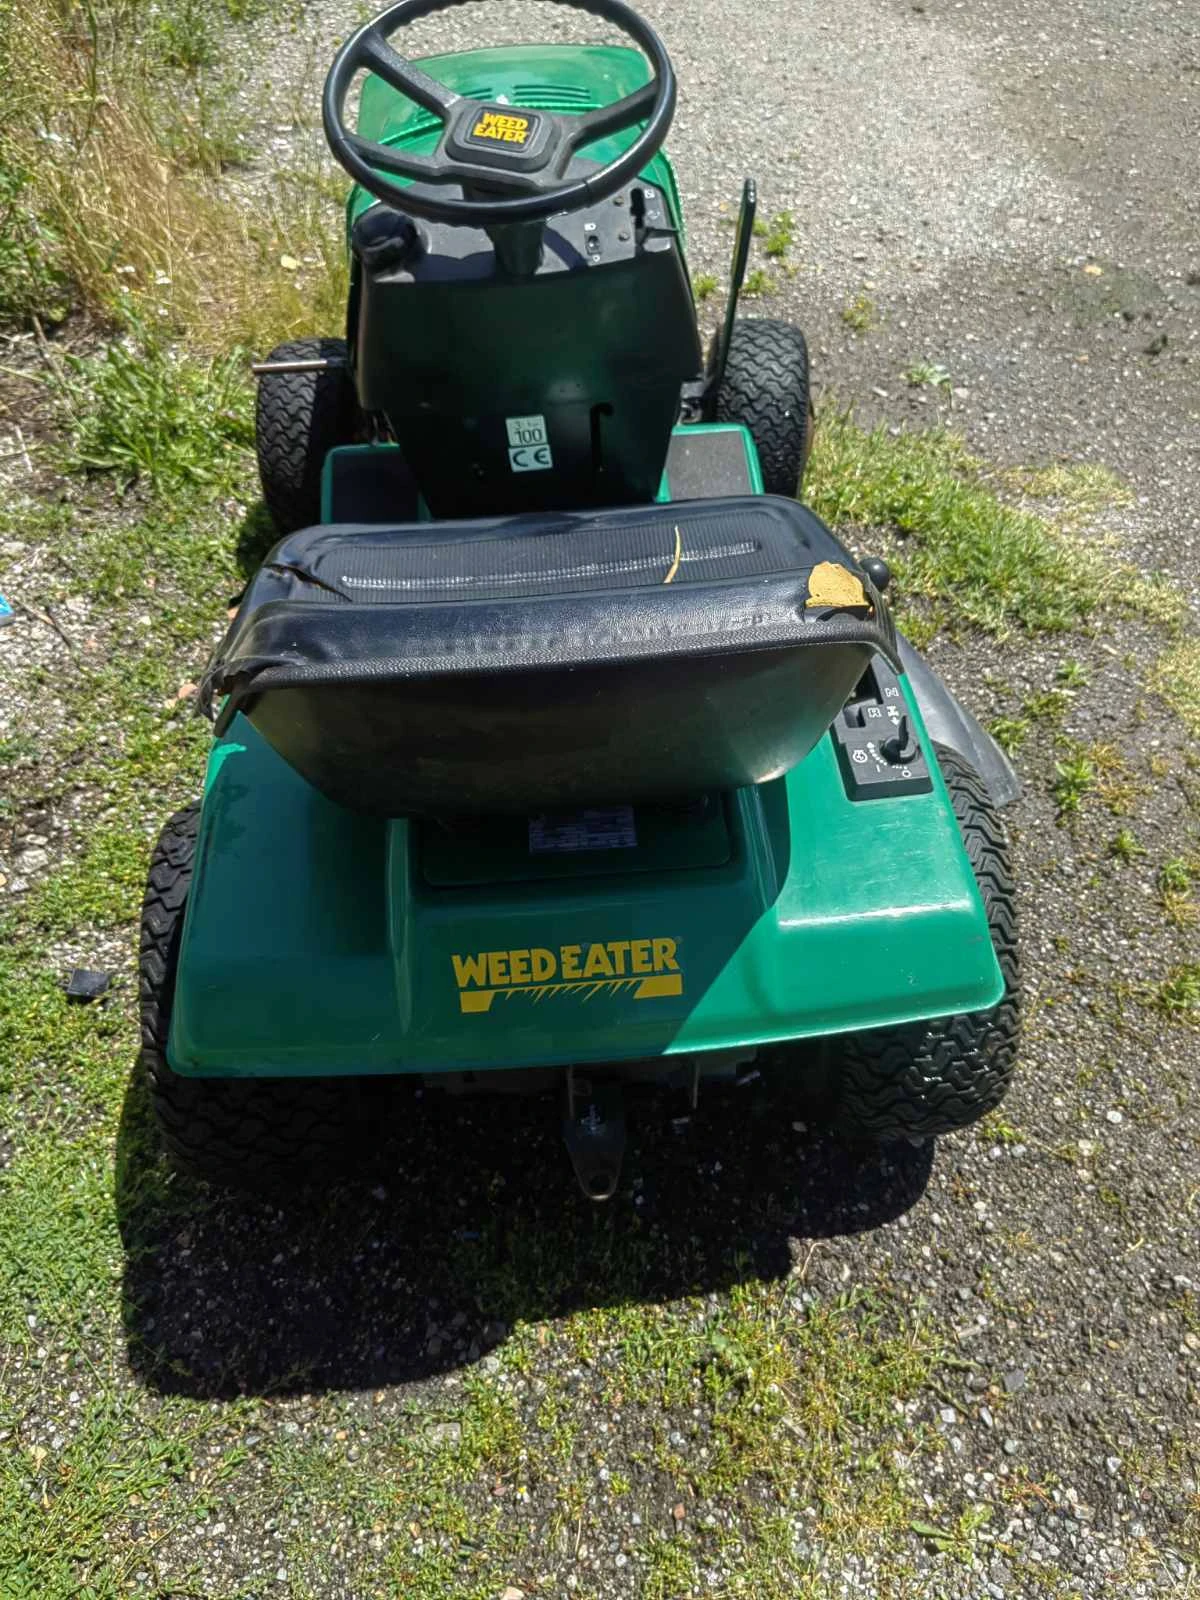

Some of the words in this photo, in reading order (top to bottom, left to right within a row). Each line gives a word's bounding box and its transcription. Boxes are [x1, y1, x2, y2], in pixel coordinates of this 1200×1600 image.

[483, 112, 529, 130] WEED
[473, 122, 528, 143] EATER
[513, 429, 542, 444] 100
[512, 447, 549, 467] CE
[452, 948, 556, 987] WEED
[560, 937, 680, 979] EATER
